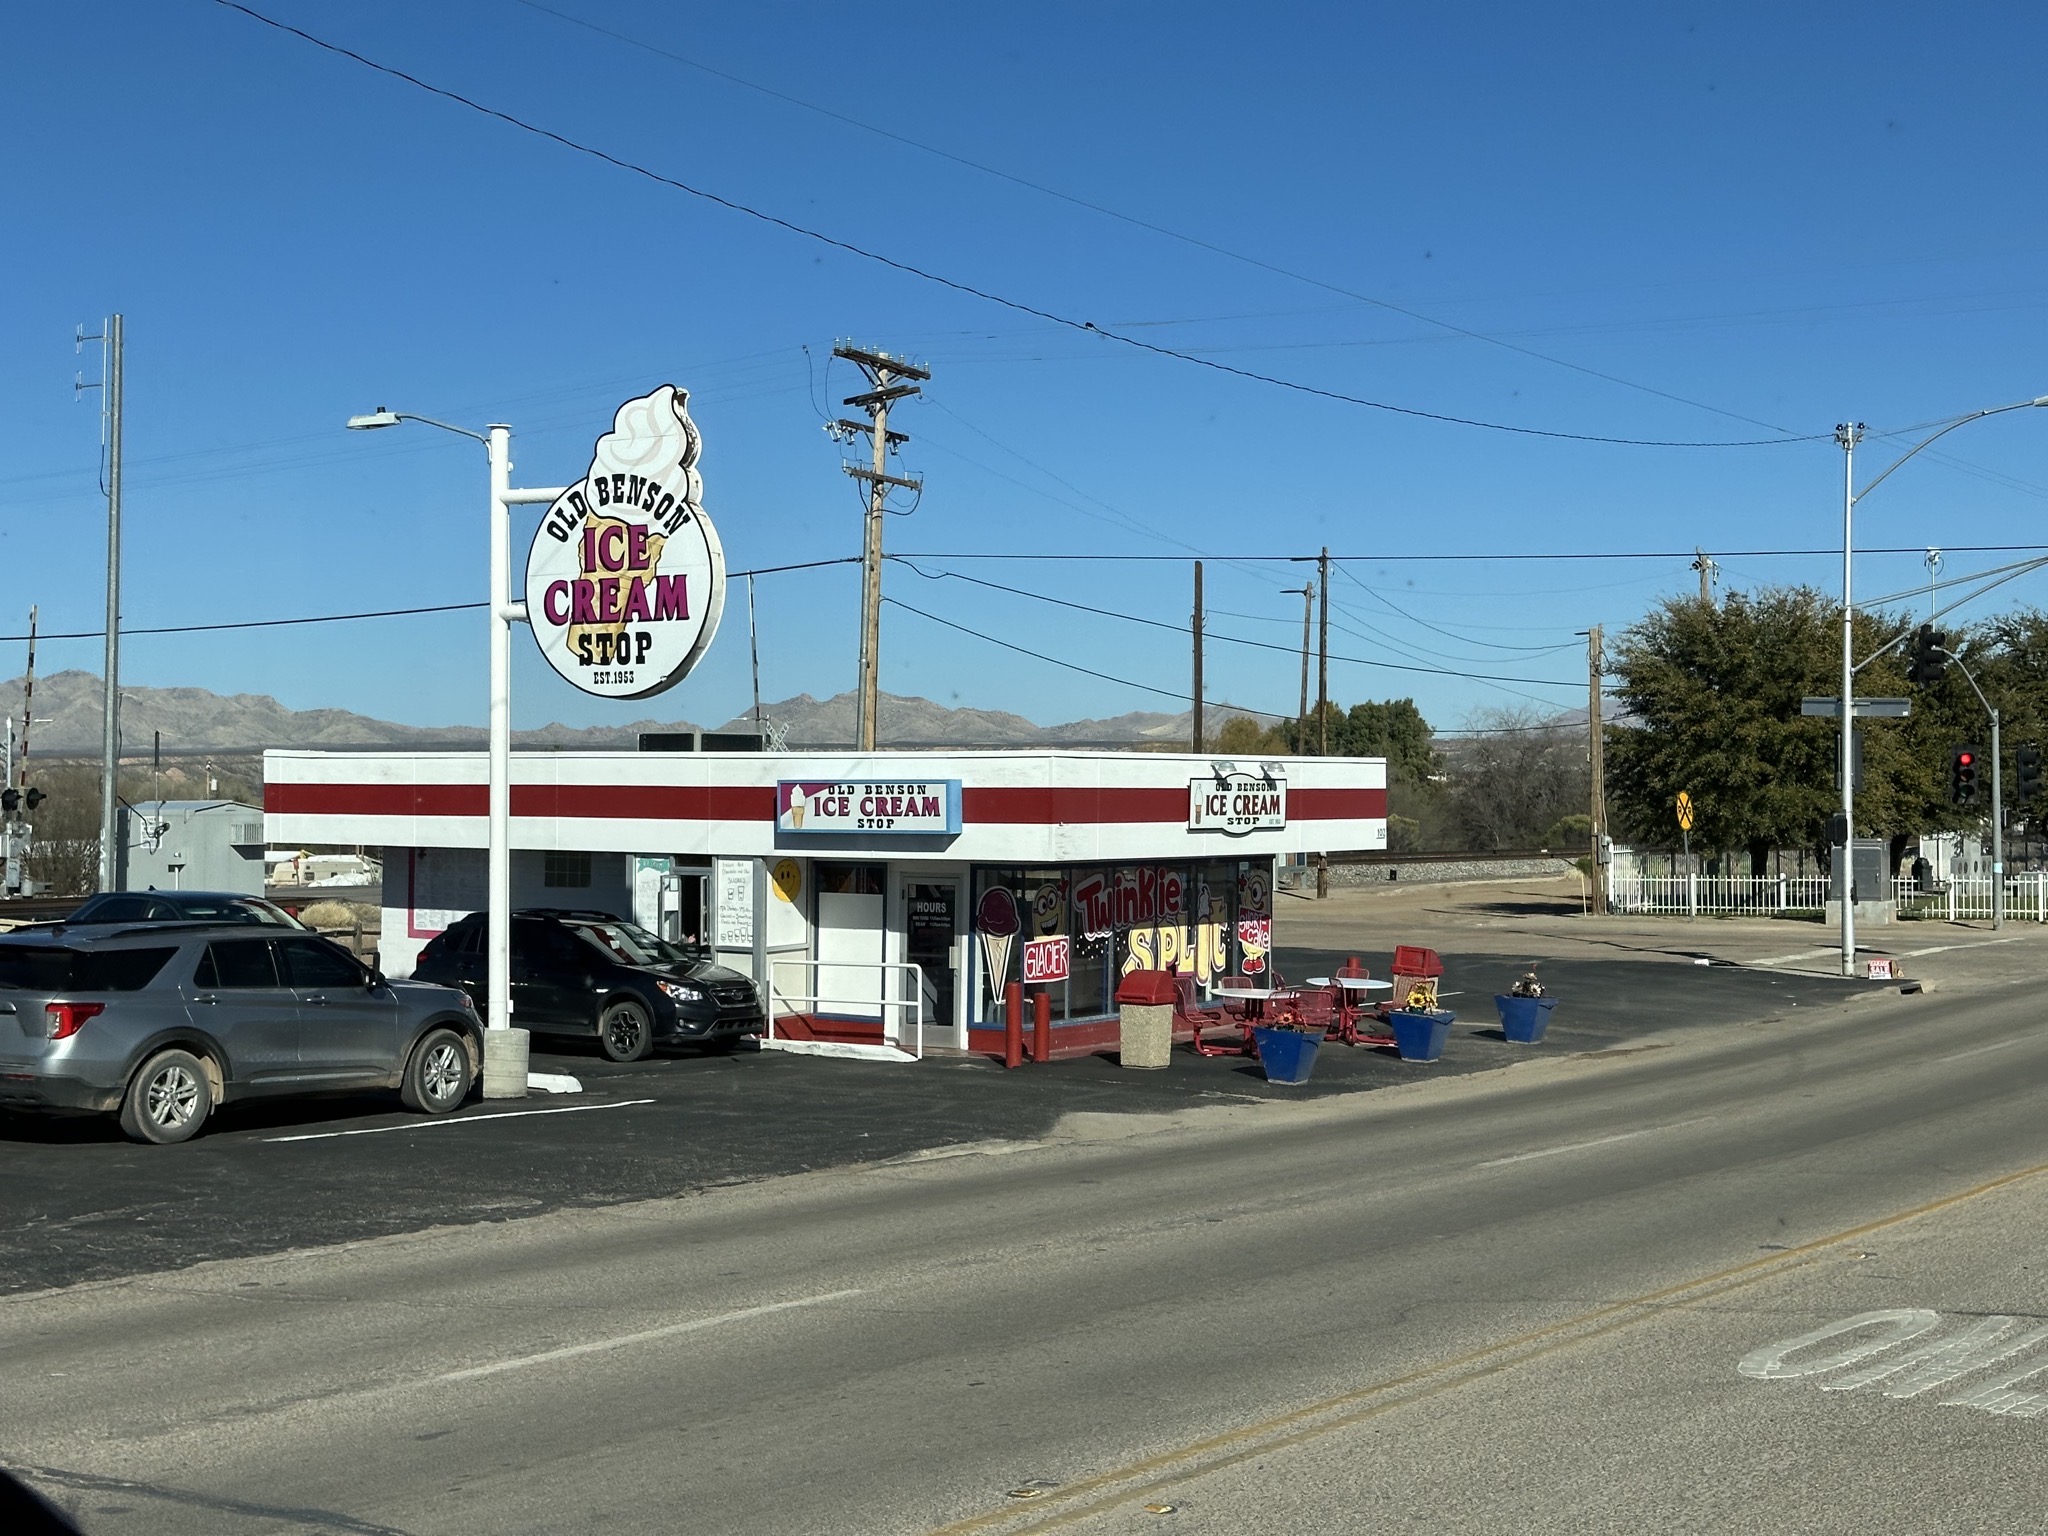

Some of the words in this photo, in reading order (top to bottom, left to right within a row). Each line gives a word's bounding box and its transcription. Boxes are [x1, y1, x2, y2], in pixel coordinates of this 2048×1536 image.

[547, 491, 588, 543] OLD
[594, 474, 691, 535] BENSON
[583, 524, 651, 572] ICE
[543, 574, 690, 626] CREAM
[579, 631, 652, 666] STOP
[828, 785, 855, 794] OLD
[864, 785, 927, 794] BENSON
[1216, 783, 1233, 792] OLD
[1237, 783, 1273, 792] BENSON
[814, 796, 851, 817] ICE
[859, 796, 941, 817] CREAM
[1205, 794, 1227, 816] ICE
[1233, 794, 1280, 816] CREAM
[857, 819, 895, 829] STOP
[1227, 817, 1260, 825] STOP
[917, 901, 947, 913] HOURS
[1026, 941, 1068, 978] GLACIER
[1870, 966, 1890, 974] SALE
